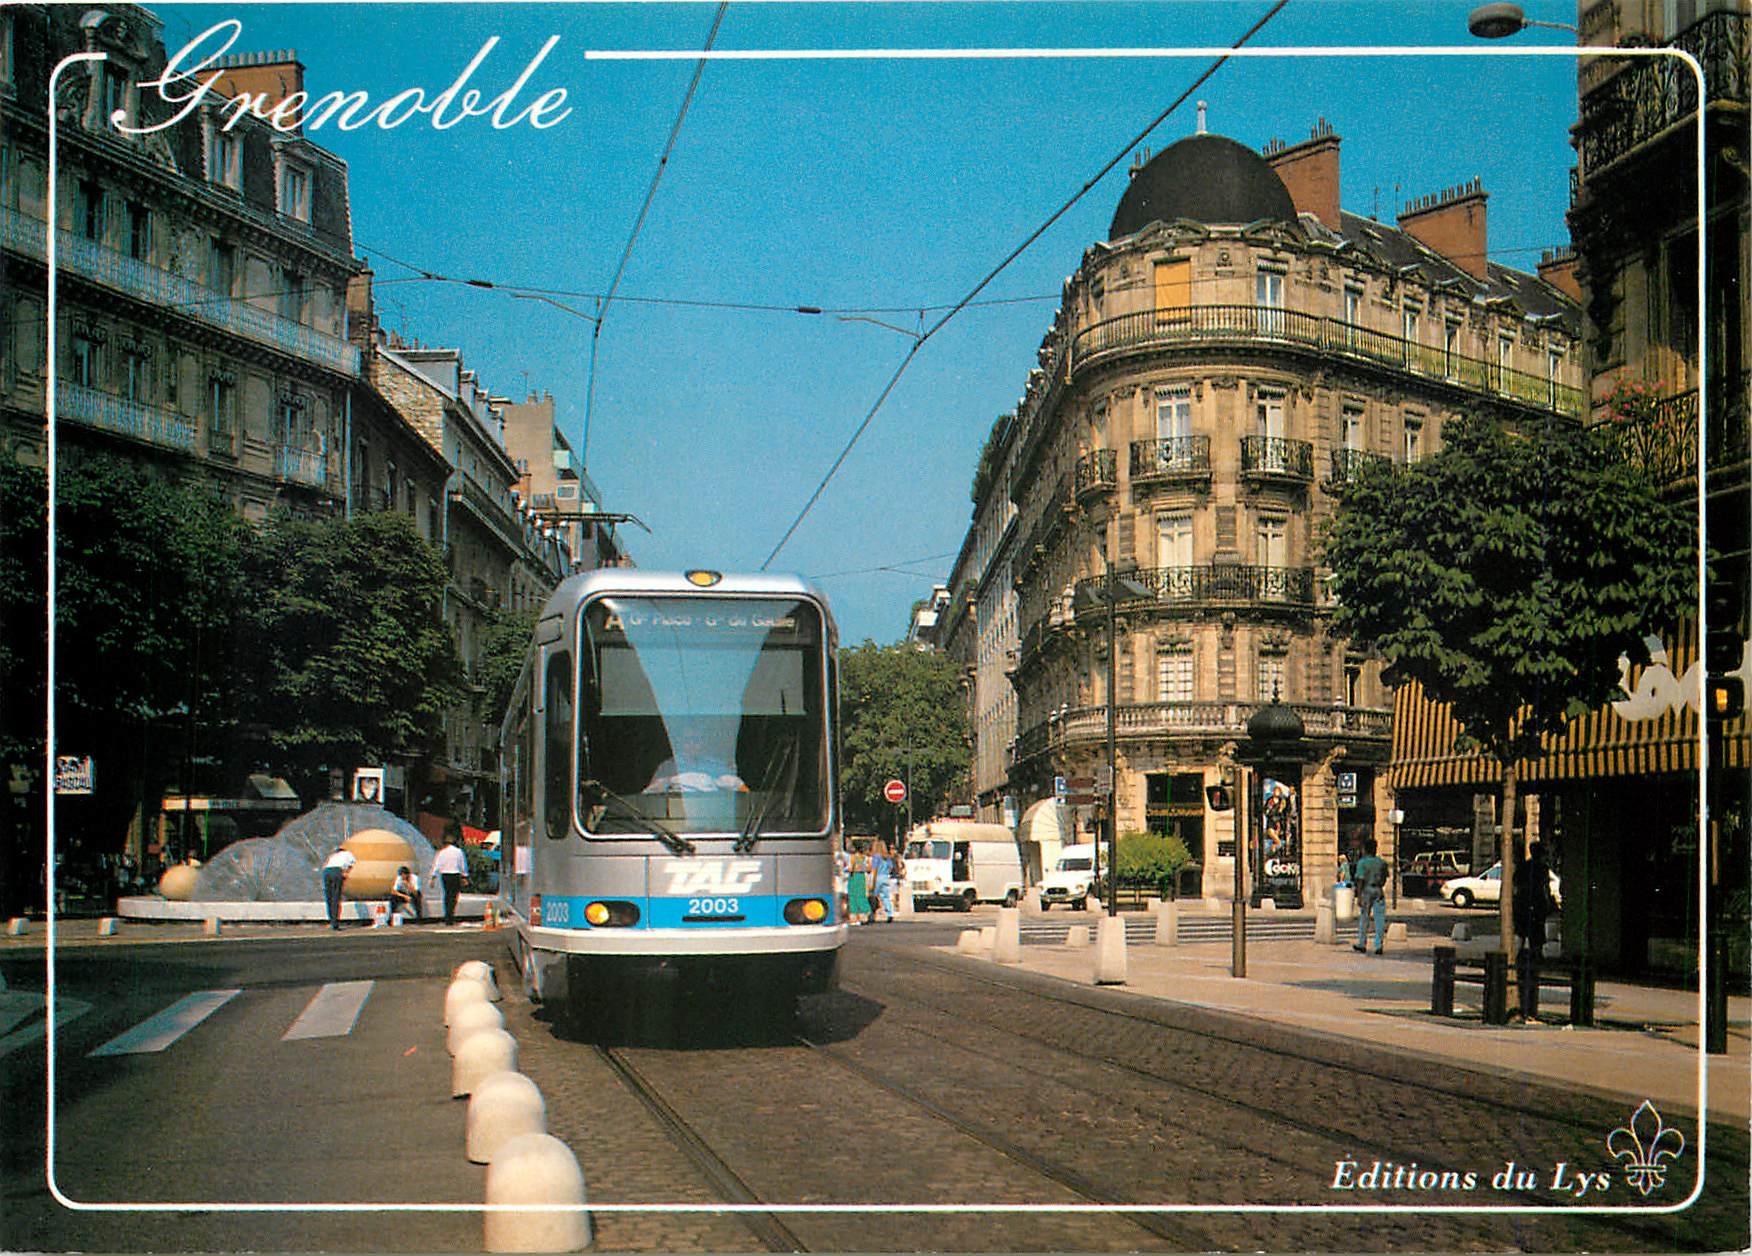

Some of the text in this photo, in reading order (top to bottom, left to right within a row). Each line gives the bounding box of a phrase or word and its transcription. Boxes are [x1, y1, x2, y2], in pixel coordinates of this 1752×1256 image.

[604, 614, 625, 630] A
[664, 861, 762, 895] TAG
[546, 901, 569, 923] 2003
[688, 898, 739, 914] 2003
